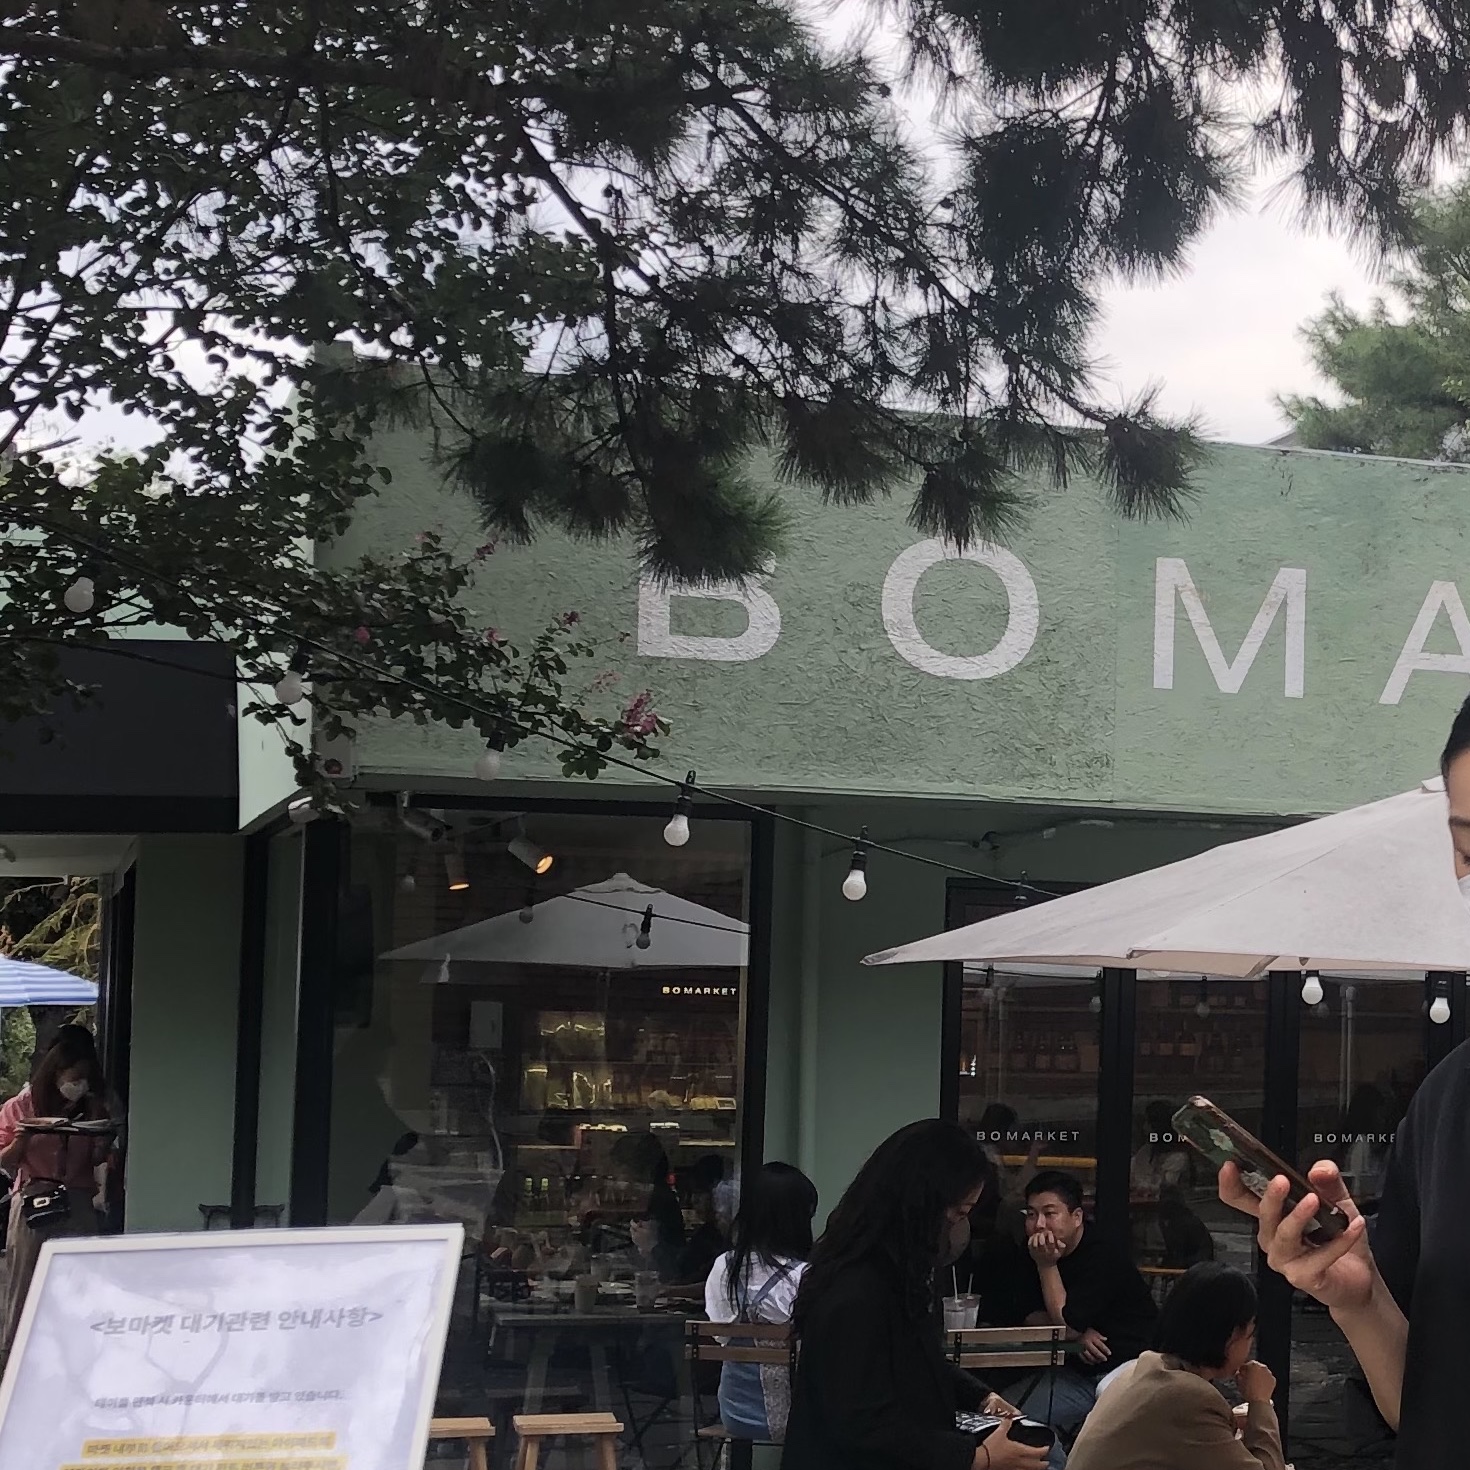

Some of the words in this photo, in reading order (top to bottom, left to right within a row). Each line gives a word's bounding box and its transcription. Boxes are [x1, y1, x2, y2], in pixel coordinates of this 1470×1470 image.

[662, 986, 737, 996] BOMARKET
[976, 1131, 1080, 1141] BOMARKET
[1314, 1133, 1396, 1143] BOMARKE
[90, 1314, 175, 1335] <보마켓
[180, 1310, 269, 1334] 대기관련
[277, 1305, 384, 1331] 안내사항>
